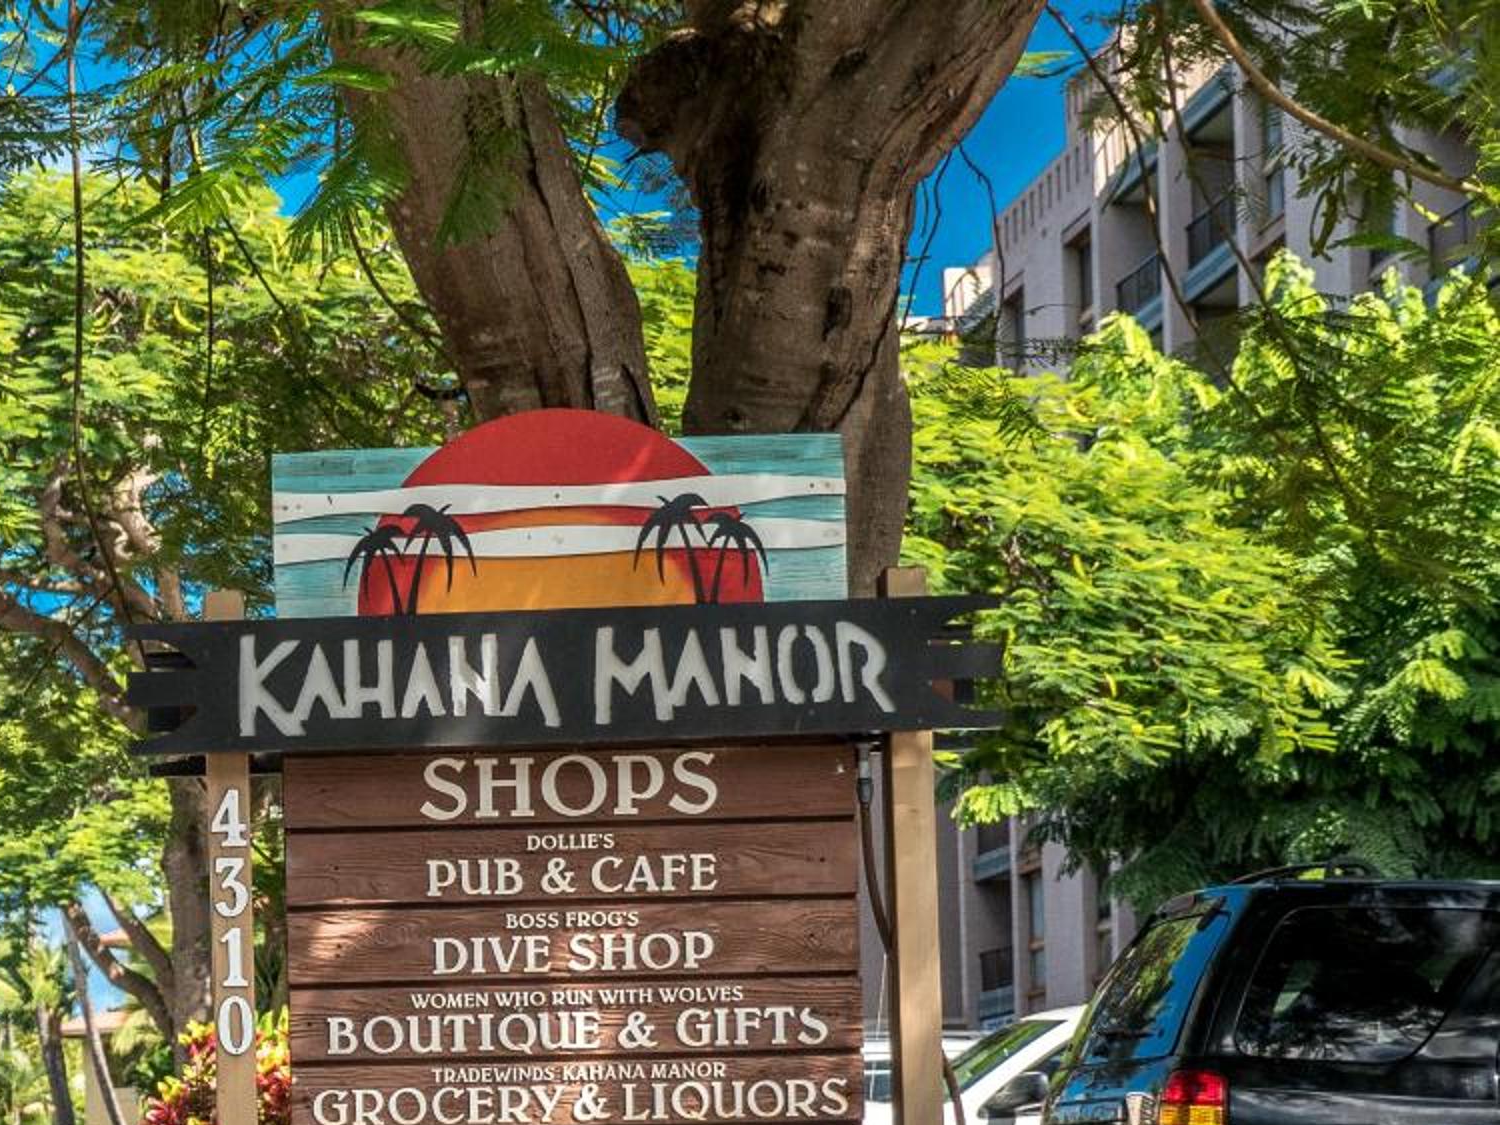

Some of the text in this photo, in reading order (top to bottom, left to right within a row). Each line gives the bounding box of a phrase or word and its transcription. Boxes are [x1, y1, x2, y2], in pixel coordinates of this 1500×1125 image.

[239, 621, 896, 737] KAHANA MANOR
[420, 751, 718, 820] SHOPS
[527, 833, 615, 851] DOLLIE'S
[426, 853, 718, 897] PUB & CAFE
[506, 911, 639, 929] BOSS FROG'S
[432, 931, 715, 975] DIVE SHOP
[411, 985, 744, 1009] WOMEN WHO RUN WITH WOLVES
[327, 1007, 829, 1055] BOUTIQUE & GIFTS
[432, 1062, 726, 1084] TRADEWINDS KAHANA MANOR
[572, 1083, 612, 1122] &
[623, 1077, 849, 1121] LIQUORS
